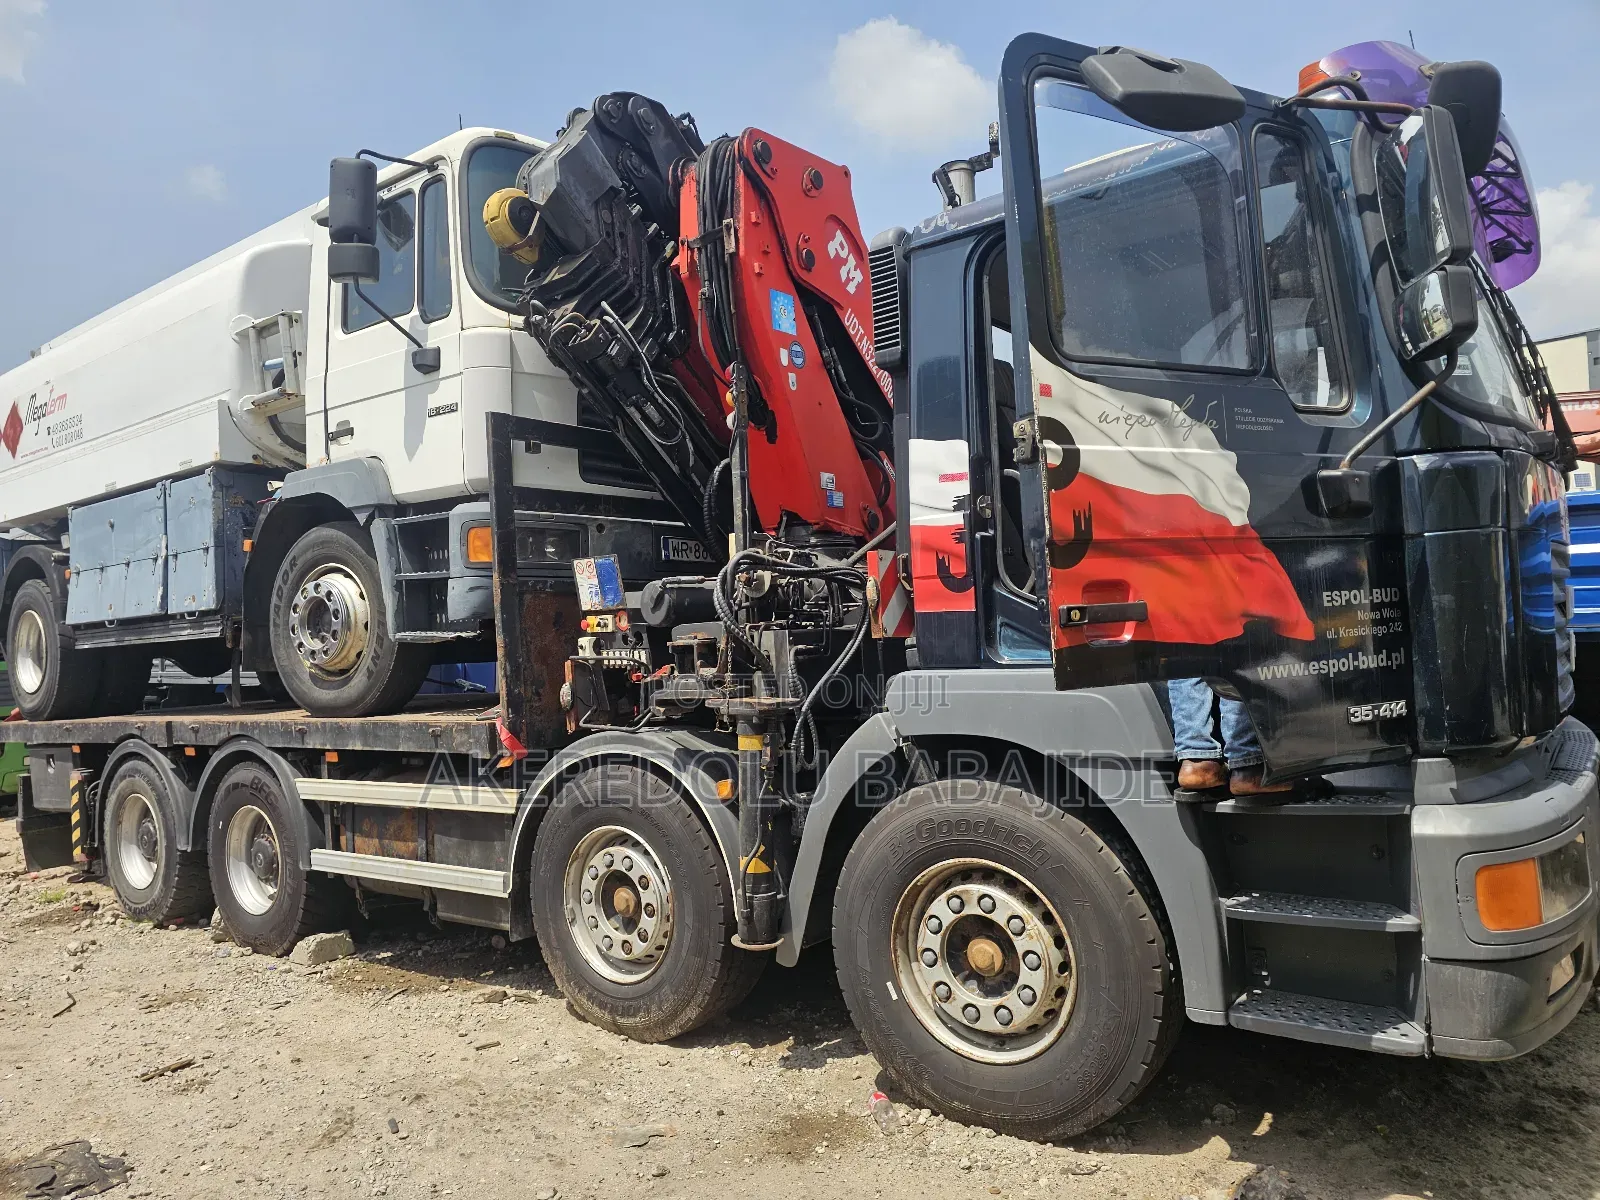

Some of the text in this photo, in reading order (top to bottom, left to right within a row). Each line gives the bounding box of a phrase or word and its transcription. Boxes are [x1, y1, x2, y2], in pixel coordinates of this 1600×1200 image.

[828, 229, 863, 295] PM
[671, 540, 690, 559] WR
[1322, 587, 1401, 607] ESPOL-BUD
[1357, 608, 1402, 621] Nowa Wola
[1326, 621, 1403, 639] ul. Krasickiego 242
[1257, 648, 1405, 681] www.espol-bud.pl
[884, 817, 1051, 867] BFGoodrich
